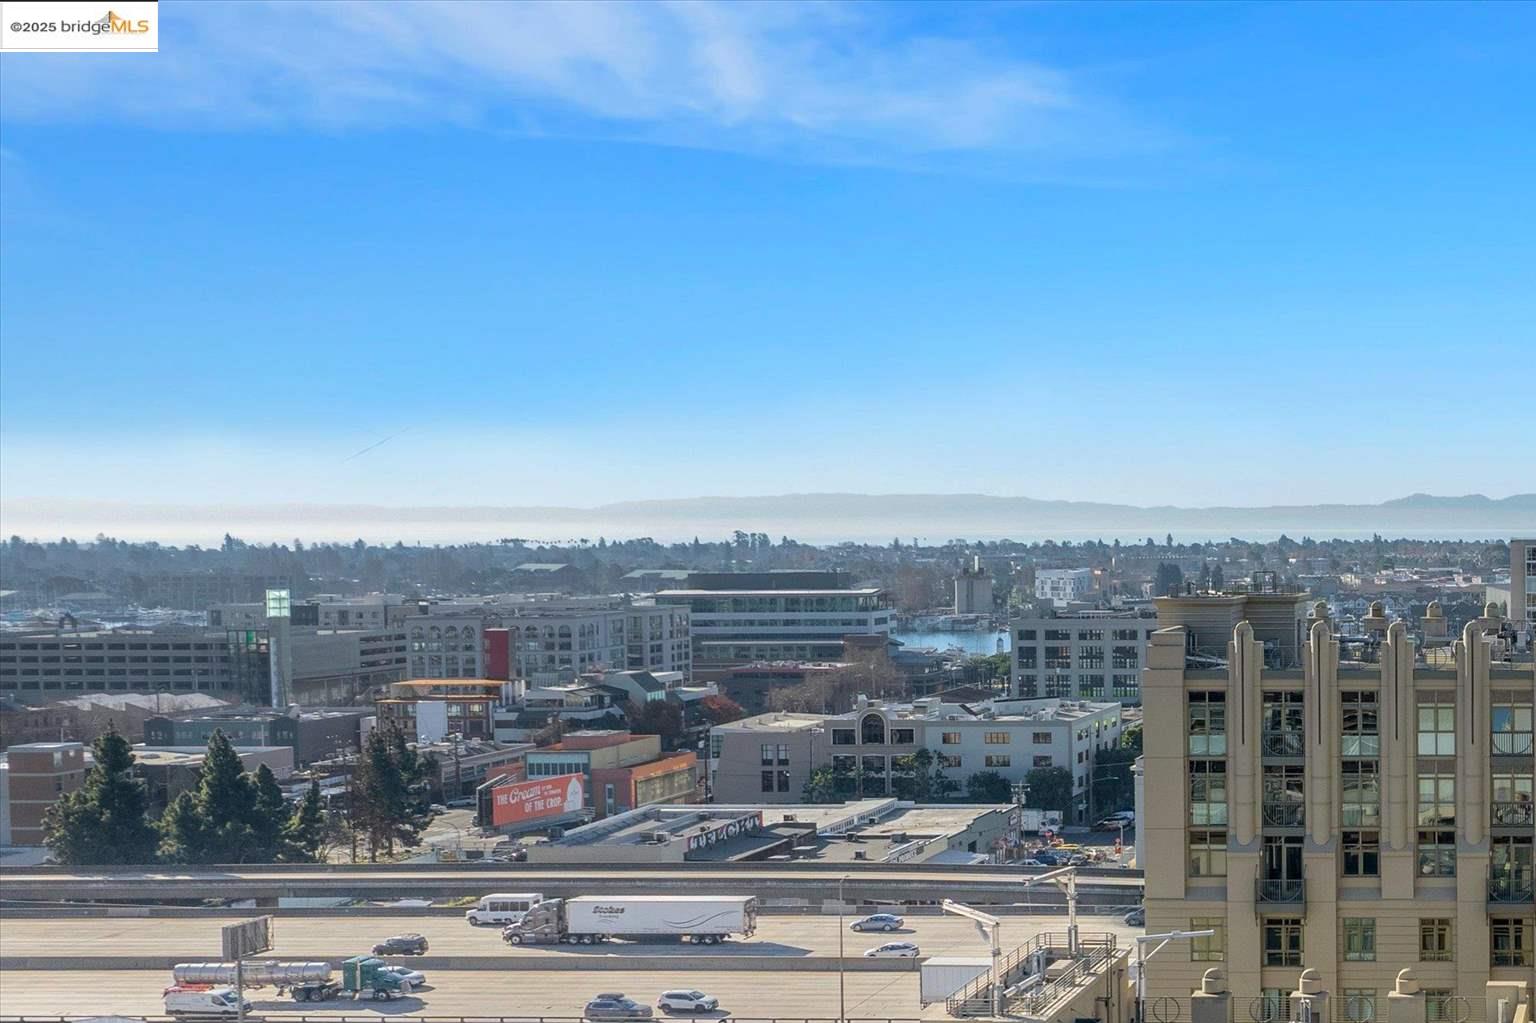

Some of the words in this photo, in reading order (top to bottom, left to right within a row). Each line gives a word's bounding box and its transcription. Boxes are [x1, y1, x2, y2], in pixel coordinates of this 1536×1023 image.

[497, 794, 508, 805] THE
[524, 802, 533, 812] OF
[535, 800, 544, 811] THE
